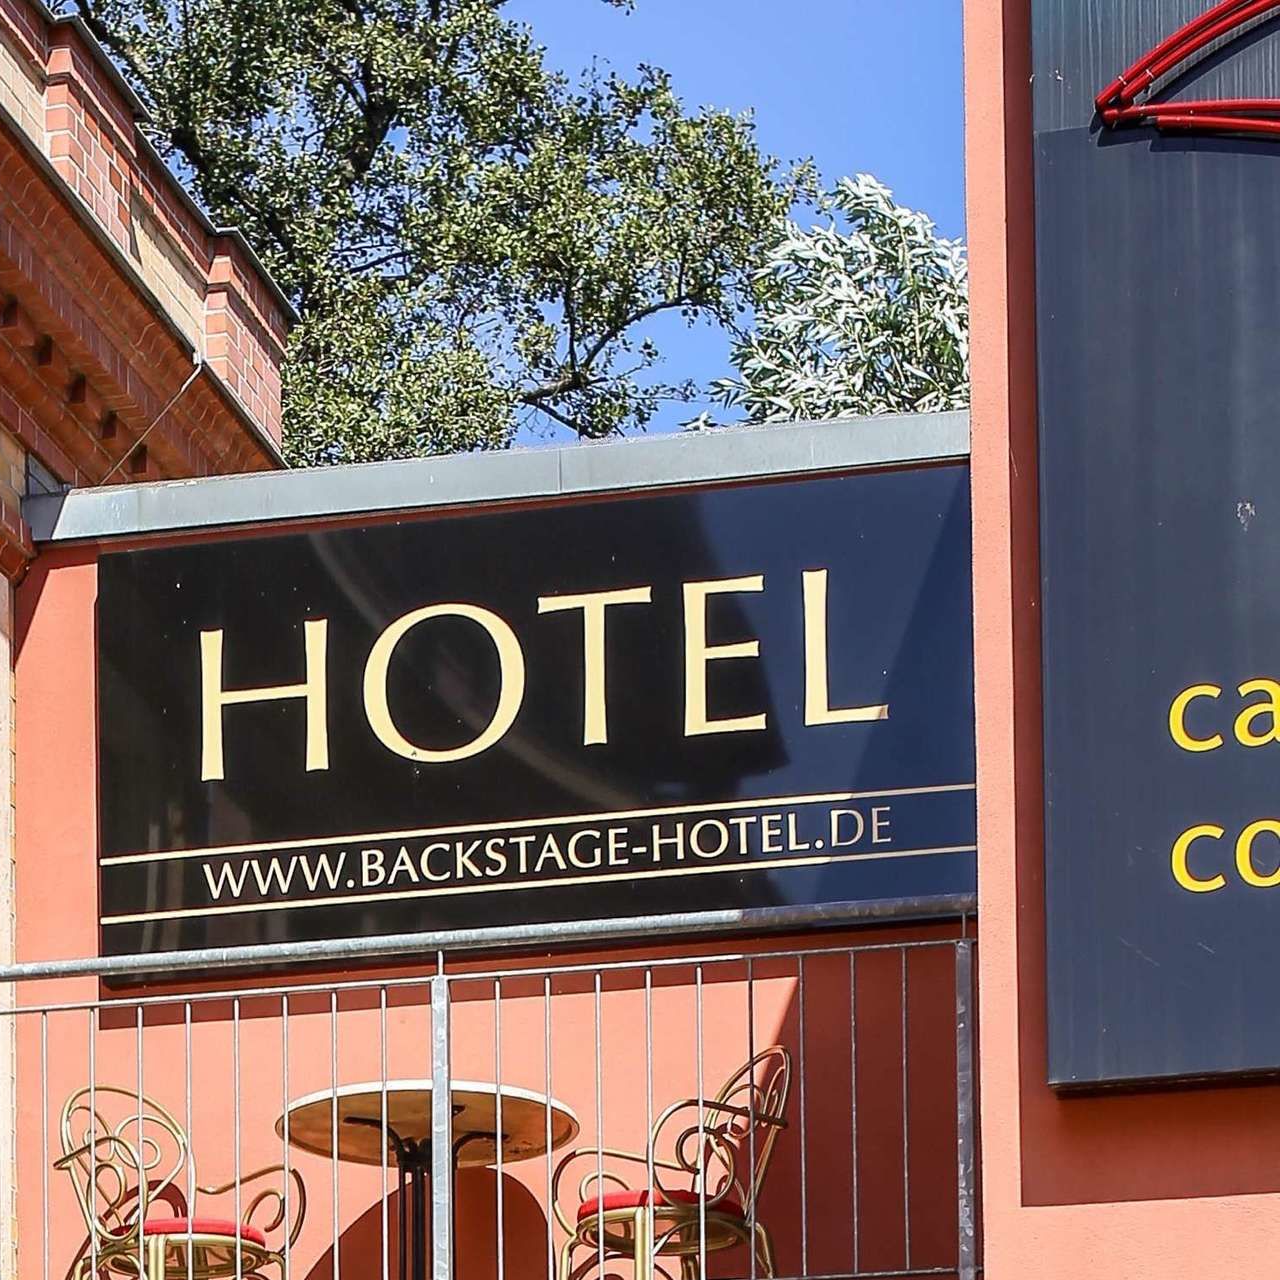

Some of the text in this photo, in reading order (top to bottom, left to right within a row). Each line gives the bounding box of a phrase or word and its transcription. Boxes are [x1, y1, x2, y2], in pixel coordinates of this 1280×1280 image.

[199, 568, 890, 783] HOTEL
[1168, 677, 1280, 753] ca
[202, 806, 894, 902] WWW.BACKSTAGE-HOTEL.DE
[1170, 818, 1280, 894] co
